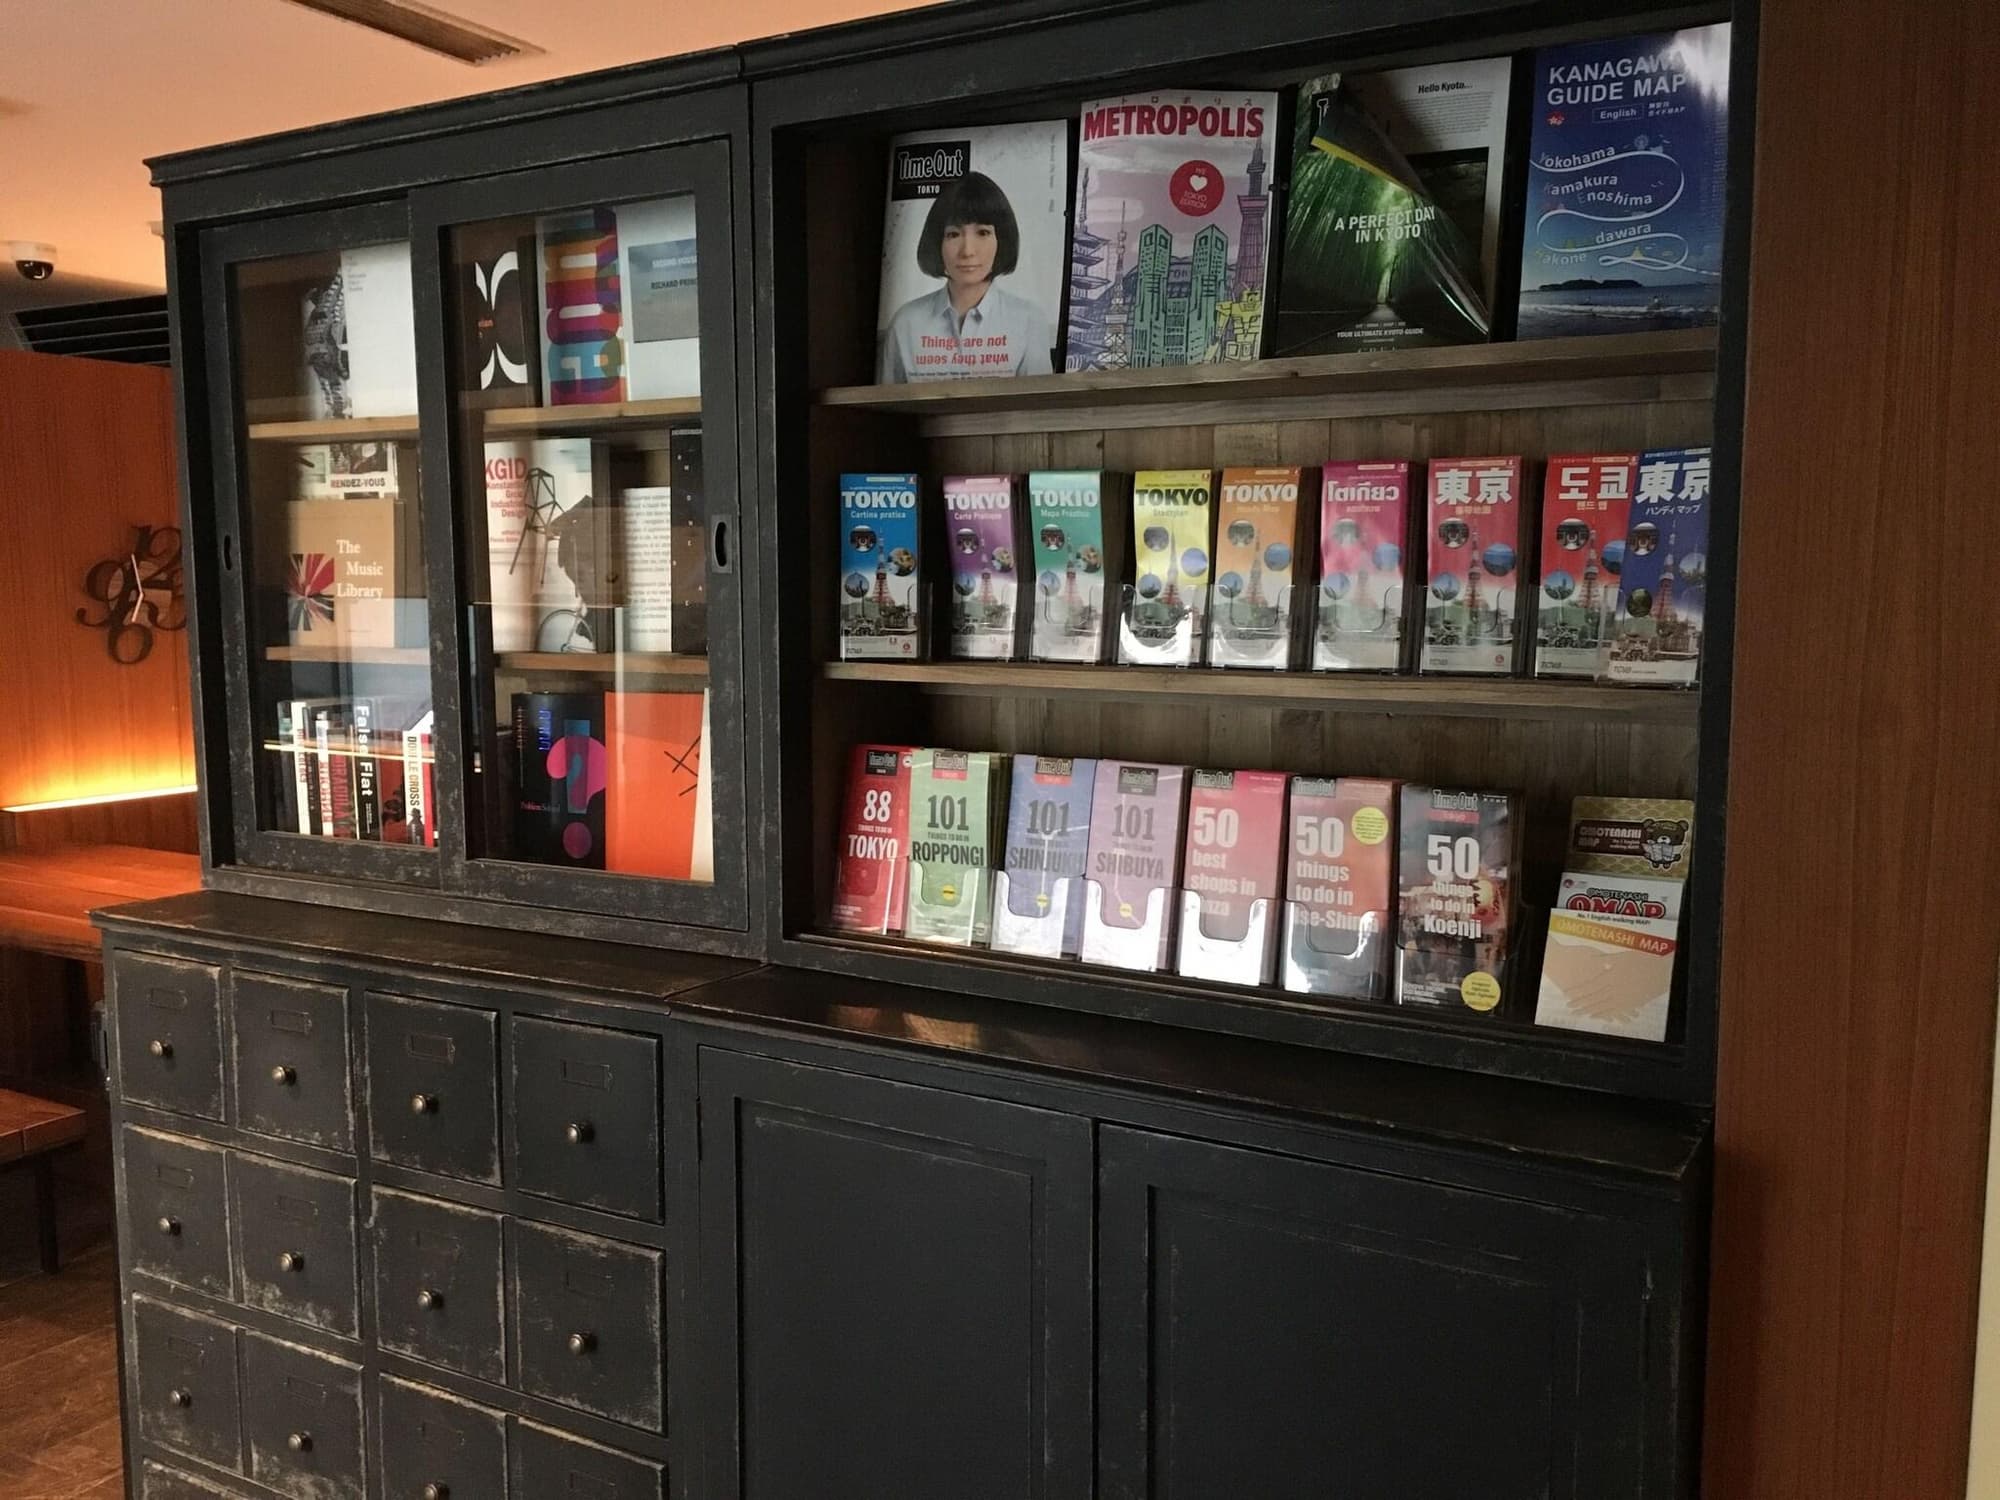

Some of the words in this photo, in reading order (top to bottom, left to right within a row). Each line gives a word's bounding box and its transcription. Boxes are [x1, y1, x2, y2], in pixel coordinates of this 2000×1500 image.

[1549, 50, 1686, 84] KANAGAWA
[1418, 84, 1440, 94] Hello
[1547, 82, 1624, 105] GUIDE
[1633, 73, 1687, 98] MAP
[1084, 105, 1265, 141] METROPOLIS
[1600, 108, 1637, 121] English
[918, 185, 940, 194] TOKYO
[1334, 217, 1345, 231] A
[1349, 209, 1413, 230] PERFECT
[1415, 206, 1436, 222] DAY
[1355, 229, 1371, 243] IN
[1375, 224, 1421, 241] KYOTO
[921, 335, 960, 350] Things
[964, 337, 983, 347] are
[987, 335, 1007, 346] not
[1354, 329, 1382, 337] ULTIMATE
[1384, 328, 1403, 336] KYOTO
[916, 354, 947, 365] seem
[952, 352, 976, 367] they
[981, 353, 1009, 366] what
[486, 458, 527, 480] KGID
[1635, 457, 1711, 503] 東京
[330, 477, 386, 489] RENDEZ-VOUS
[1223, 483, 1298, 503] TOKYO
[1435, 467, 1514, 505] 東京
[1559, 466, 1629, 499] 도쿄
[841, 491, 916, 509] TOKYO
[944, 492, 1011, 511] TOKYO
[1031, 489, 1099, 507] TOKIO
[1135, 488, 1209, 506] TOKYO
[851, 511, 878, 519] Cartina
[880, 511, 906, 521] pratica
[336, 539, 361, 554] The
[346, 562, 383, 576] Music
[336, 583, 383, 600] Library
[357, 706, 371, 755] False
[359, 761, 374, 796] Flat
[408, 776, 421, 806] CROSS
[863, 789, 892, 822] 88
[927, 795, 969, 830] 101
[1026, 799, 1070, 837] 101
[1112, 804, 1155, 840] 101
[1193, 806, 1239, 848] 50
[848, 834, 898, 860] TOKYO
[1296, 815, 1344, 858] 50
[912, 841, 984, 866] ROPPONGI
[1192, 849, 1227, 869] best
[1427, 834, 1480, 880] 50
[1096, 852, 1164, 880] SHIBUYA
[1296, 860, 1350, 882] things
[1190, 873, 1238, 895] shops
[1240, 878, 1256, 896] in
[1295, 884, 1312, 901] to
[1313, 885, 1335, 904] do
[1337, 887, 1354, 906] in
[1431, 898, 1442, 910] to
[1444, 899, 1461, 913] do
[1463, 901, 1475, 914] in
[1424, 914, 1482, 940] Koenji
[1559, 920, 1635, 946] OMOTENASHI
[1640, 938, 1669, 953] MAP
